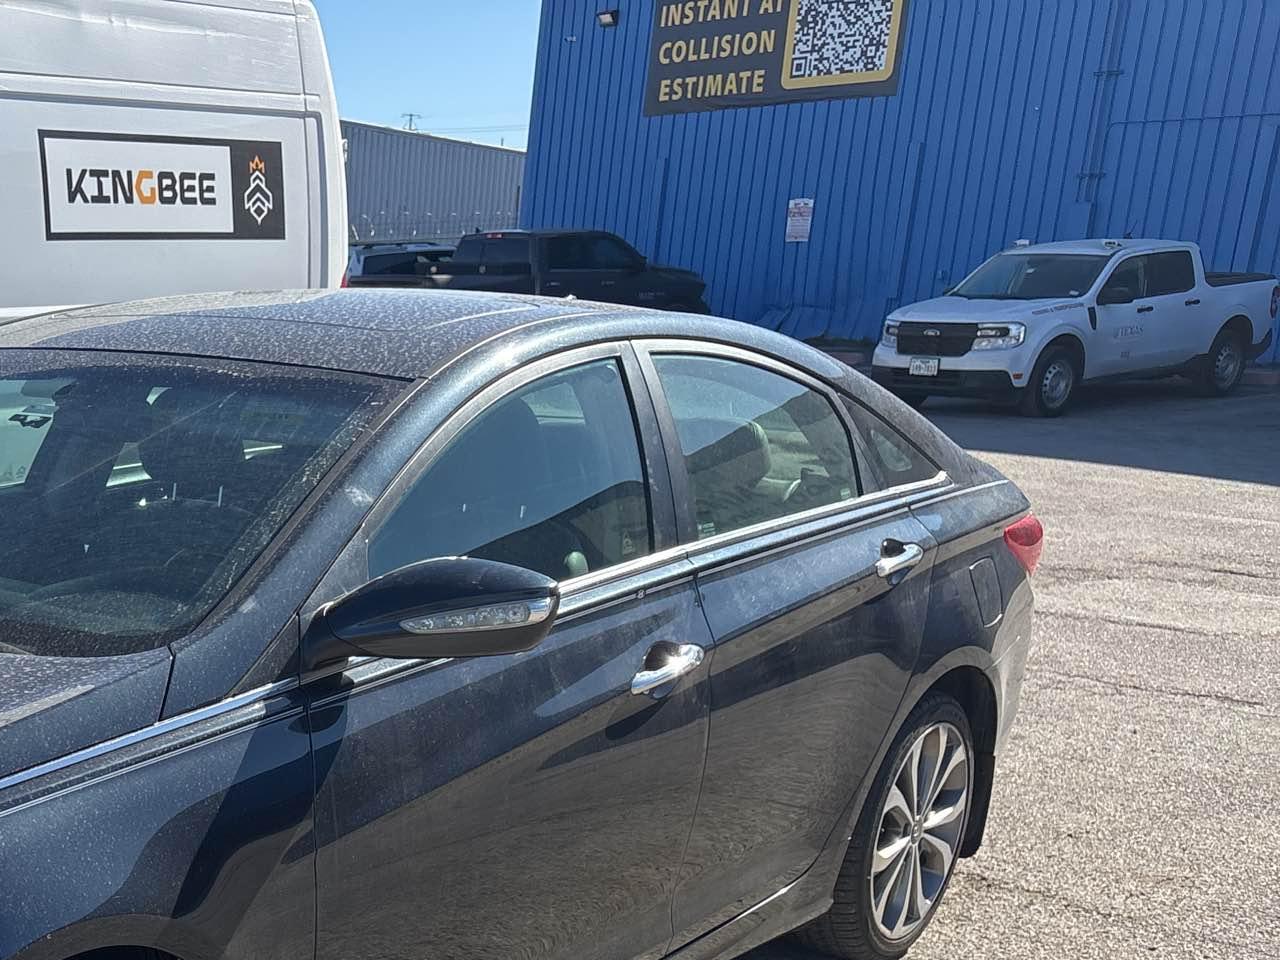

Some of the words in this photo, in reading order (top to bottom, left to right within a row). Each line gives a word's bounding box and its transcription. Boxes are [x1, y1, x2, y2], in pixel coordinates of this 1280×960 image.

[660, 0, 750, 27] INSTANT
[658, 30, 776, 65] COLLISION
[658, 69, 766, 102] ESTIMATE
[65, 168, 217, 206] KINGBEE
